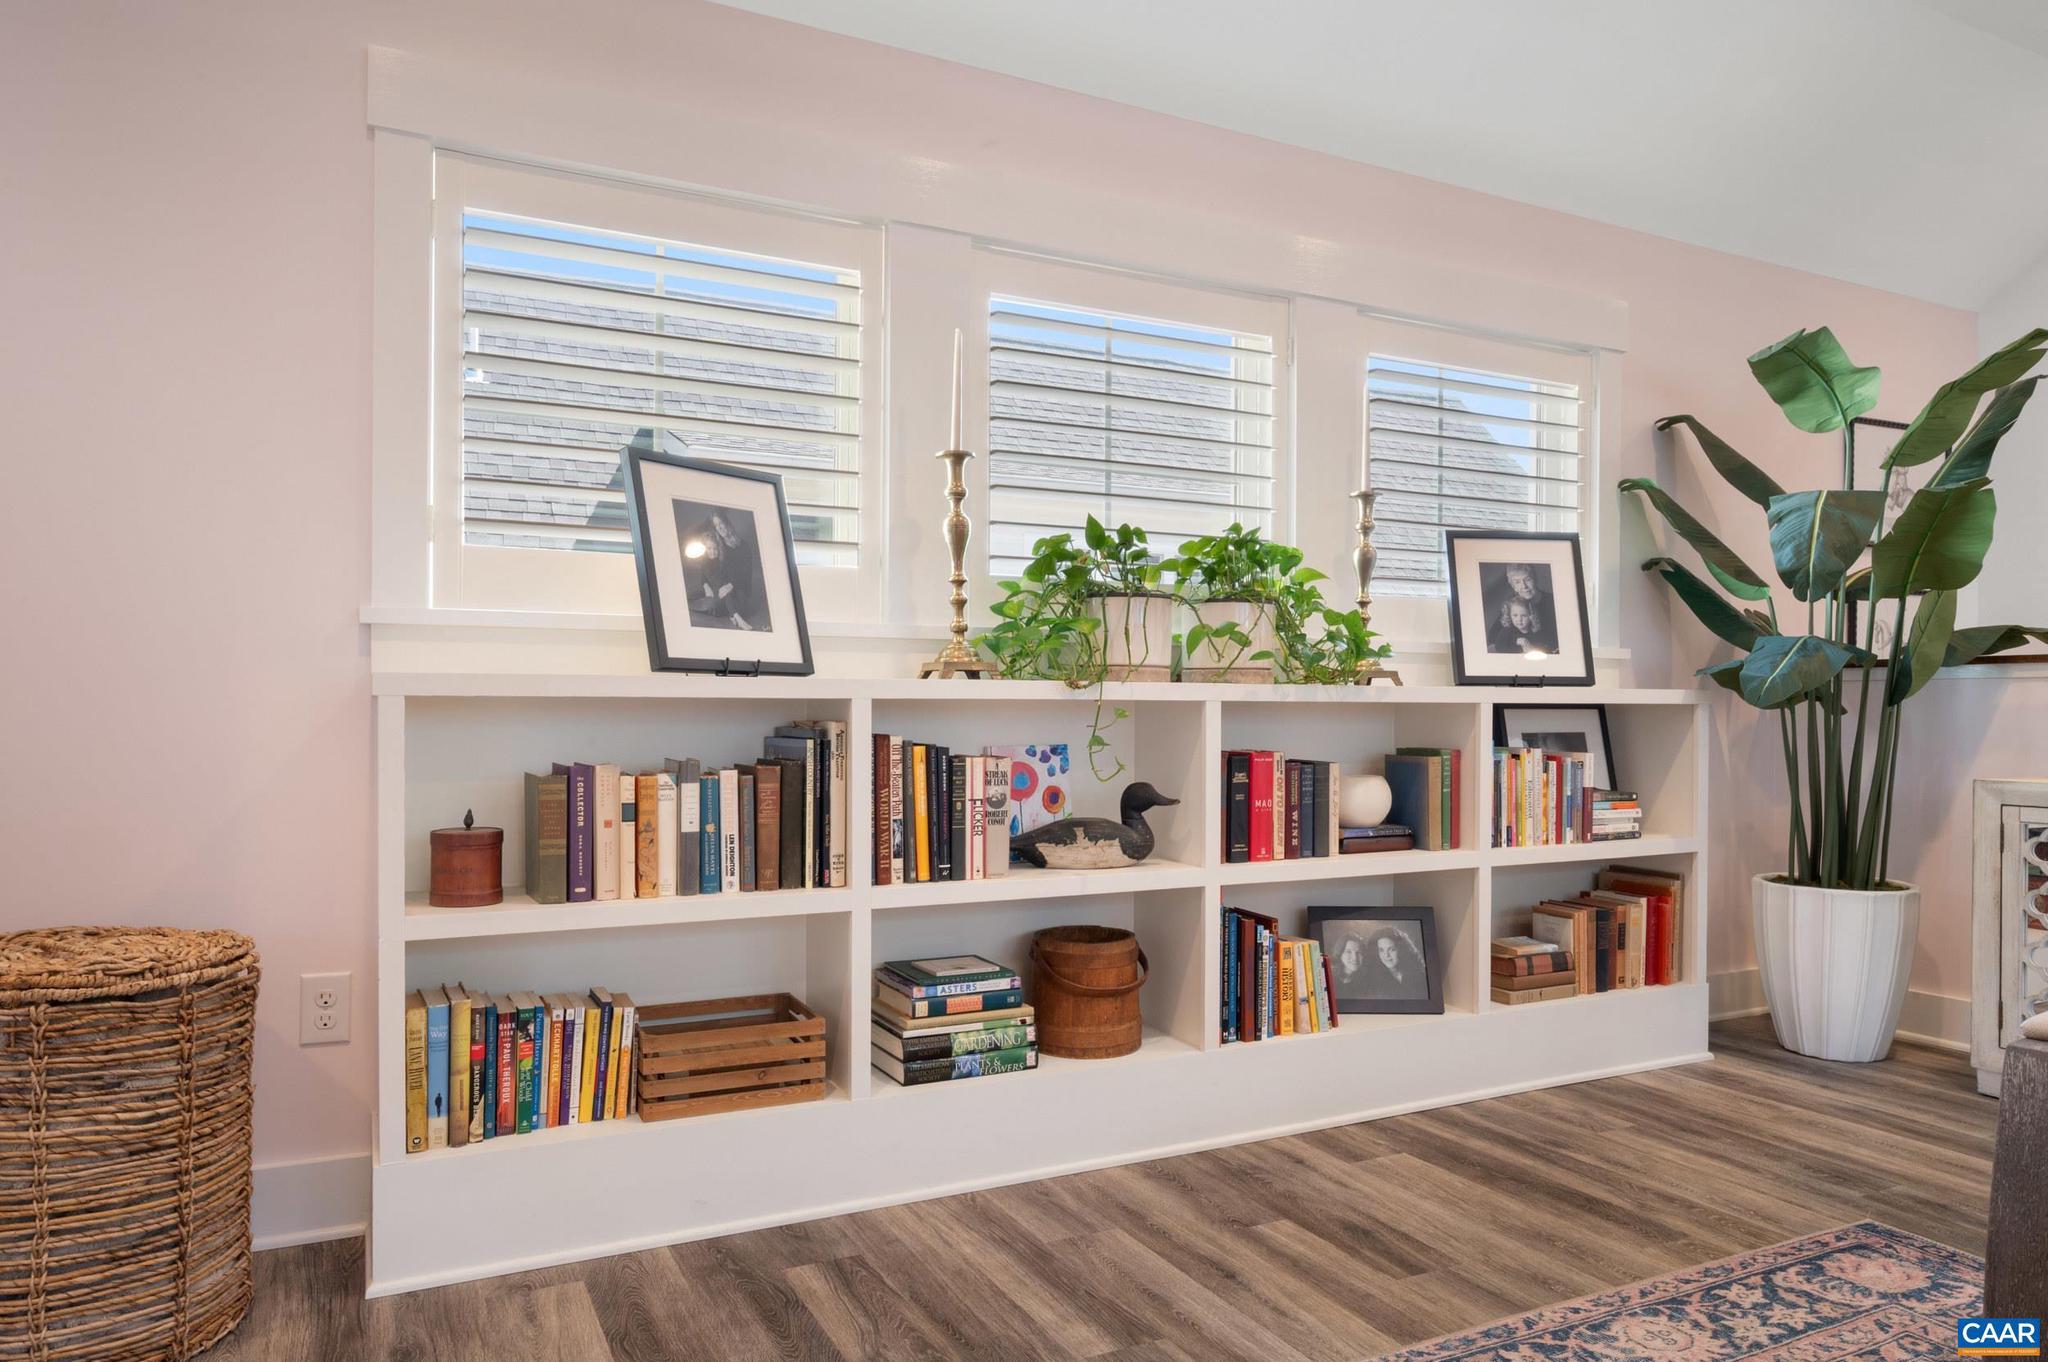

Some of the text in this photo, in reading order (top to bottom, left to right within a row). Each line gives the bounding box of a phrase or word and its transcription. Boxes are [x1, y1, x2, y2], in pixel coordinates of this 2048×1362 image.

[985, 770, 1008, 778] STREAK
[992, 778, 1008, 786] LUCK
[1277, 777, 1284, 794] ON
[880, 788, 890, 829] WORLD
[891, 798, 900, 816] Path
[1255, 800, 1272, 808] MAO
[1277, 795, 1284, 808] TO
[968, 798, 984, 836] FLICKER
[986, 810, 1008, 818] ROBERT
[880, 830, 890, 858] WAR
[939, 984, 977, 994] ASTERS
[954, 1032, 1021, 1052] GARDENING
[955, 1056, 1000, 1072] PLANTS &
[980, 1062, 1024, 1076] FLOWERS
[409, 1068, 424, 1091] RIVER
[502, 1043, 511, 1104] PAUL THEROUX
